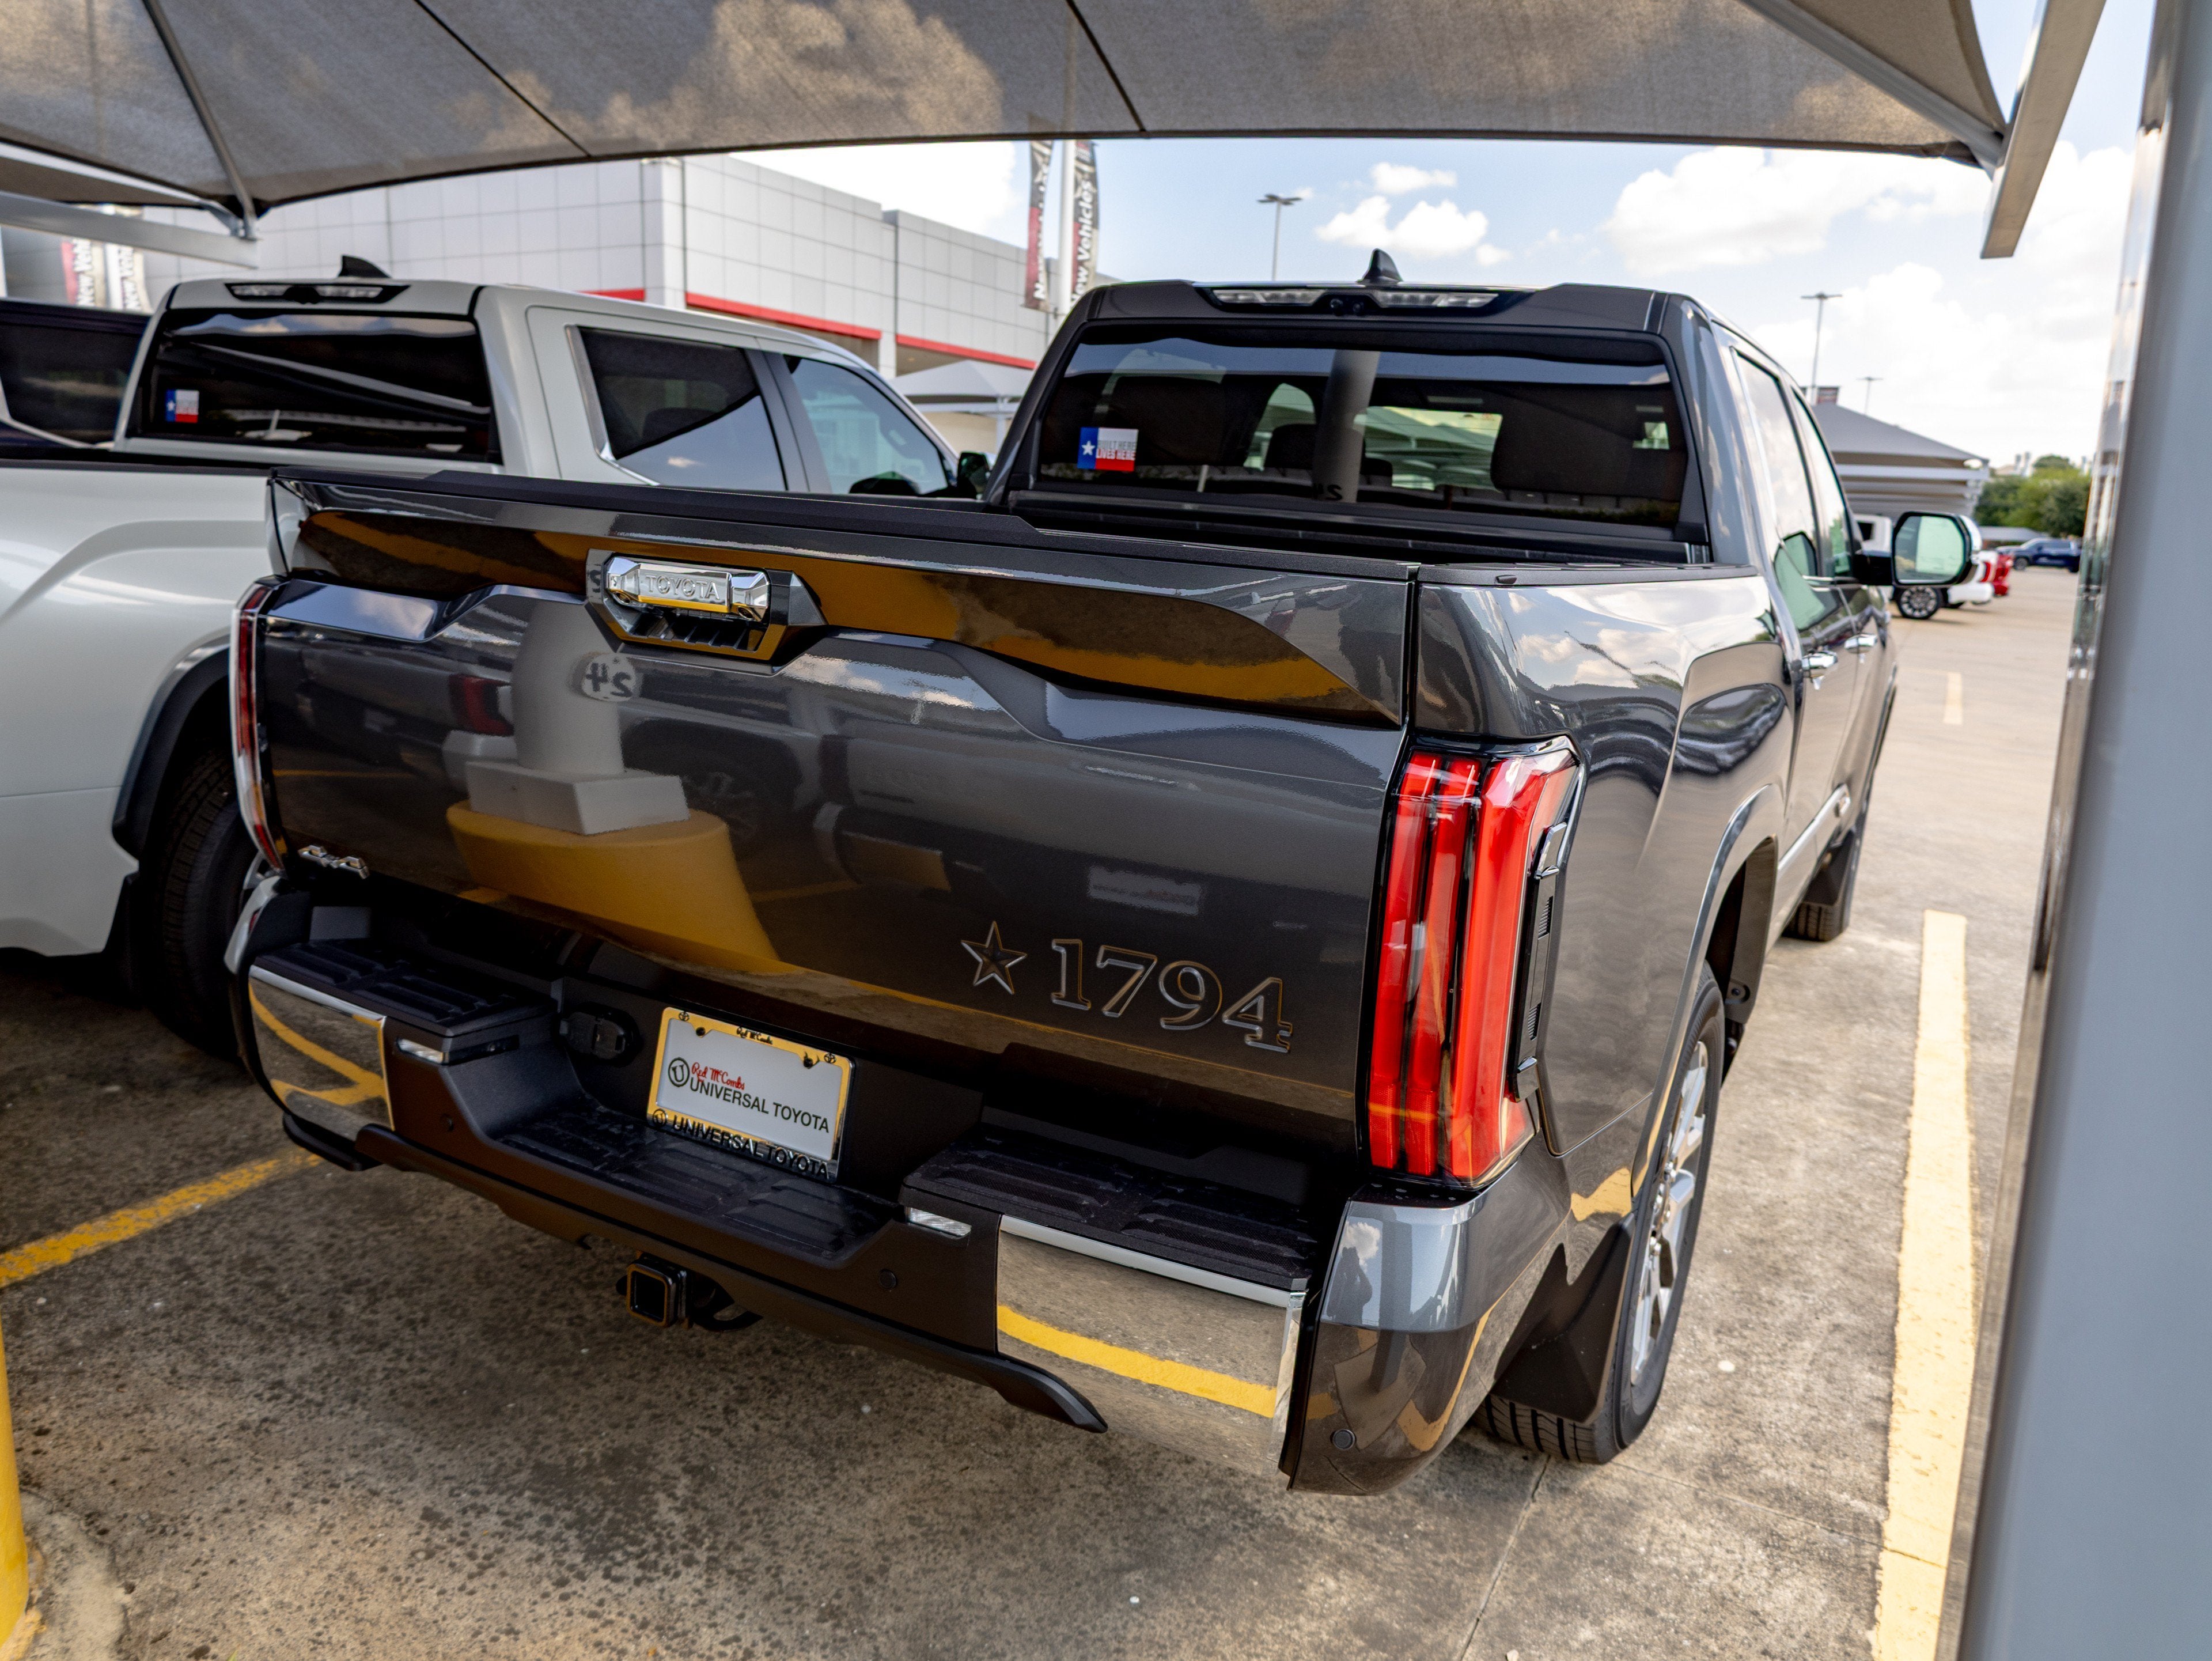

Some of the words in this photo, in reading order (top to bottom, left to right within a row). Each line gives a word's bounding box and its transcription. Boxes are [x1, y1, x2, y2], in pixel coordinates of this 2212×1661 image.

[1077, 179, 1093, 261] Vehicles
[645, 574, 720, 600] TOYOTA
[1051, 939, 1293, 1053] 1794
[690, 1076, 769, 1115] UNIVERSAL
[773, 1102, 830, 1133] TOYOTA
[692, 1062, 708, 1083] Red
[710, 1066, 745, 1090] McCombs
[673, 1115, 764, 1157] UNIVERSAL
[766, 1141, 830, 1179] TOYOTA
